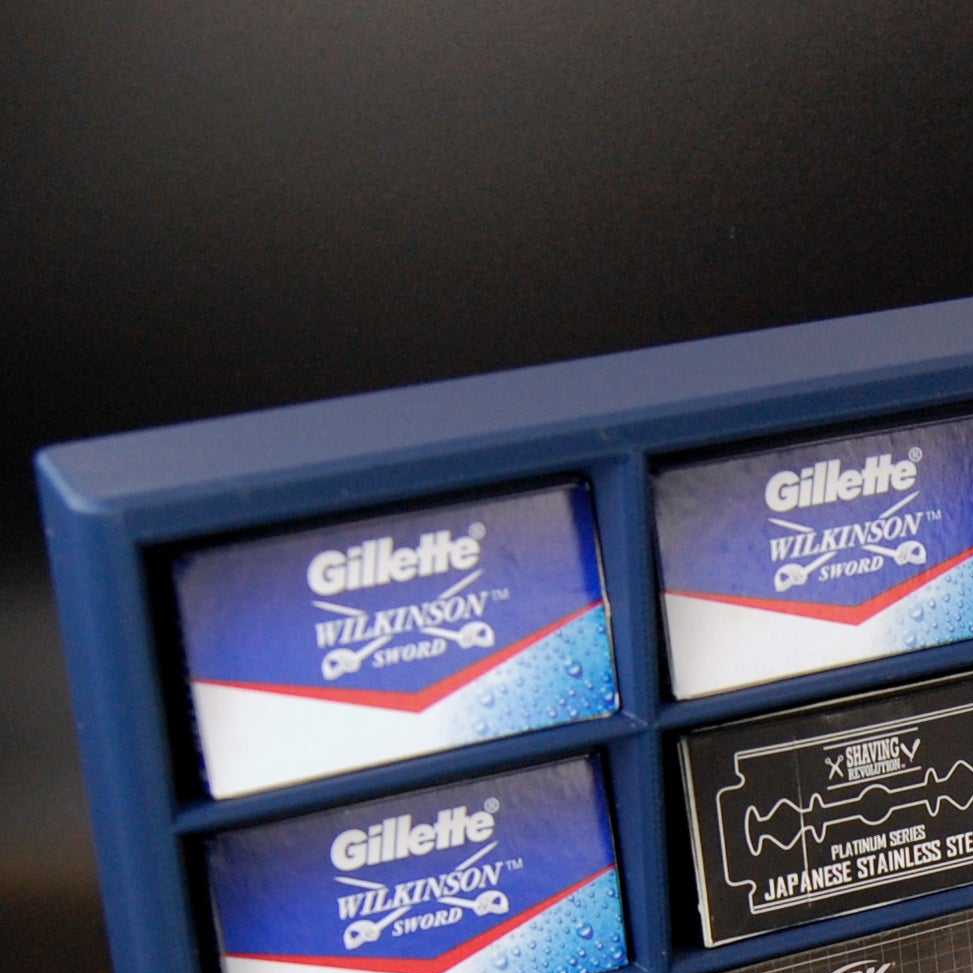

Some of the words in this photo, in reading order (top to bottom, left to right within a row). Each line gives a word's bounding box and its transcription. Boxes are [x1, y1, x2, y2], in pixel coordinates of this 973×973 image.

[765, 453, 918, 512] Gillette
[769, 512, 923, 561] WILKINSON
[307, 530, 480, 596] Gillette
[818, 556, 884, 581] SWORD
[315, 593, 487, 648] WILKINSON
[371, 639, 447, 668] SWORD
[846, 737, 899, 767] SHAVING
[848, 758, 900, 780] REVOLUTION
[330, 806, 494, 870] Gillette
[830, 834, 887, 861] PLATINUM
[889, 825, 925, 848] SERIES
[337, 862, 504, 920] WILKINSON
[764, 862, 852, 901] JAPANESE
[857, 842, 941, 879] STAINLESS
[392, 908, 462, 937] SWORD
